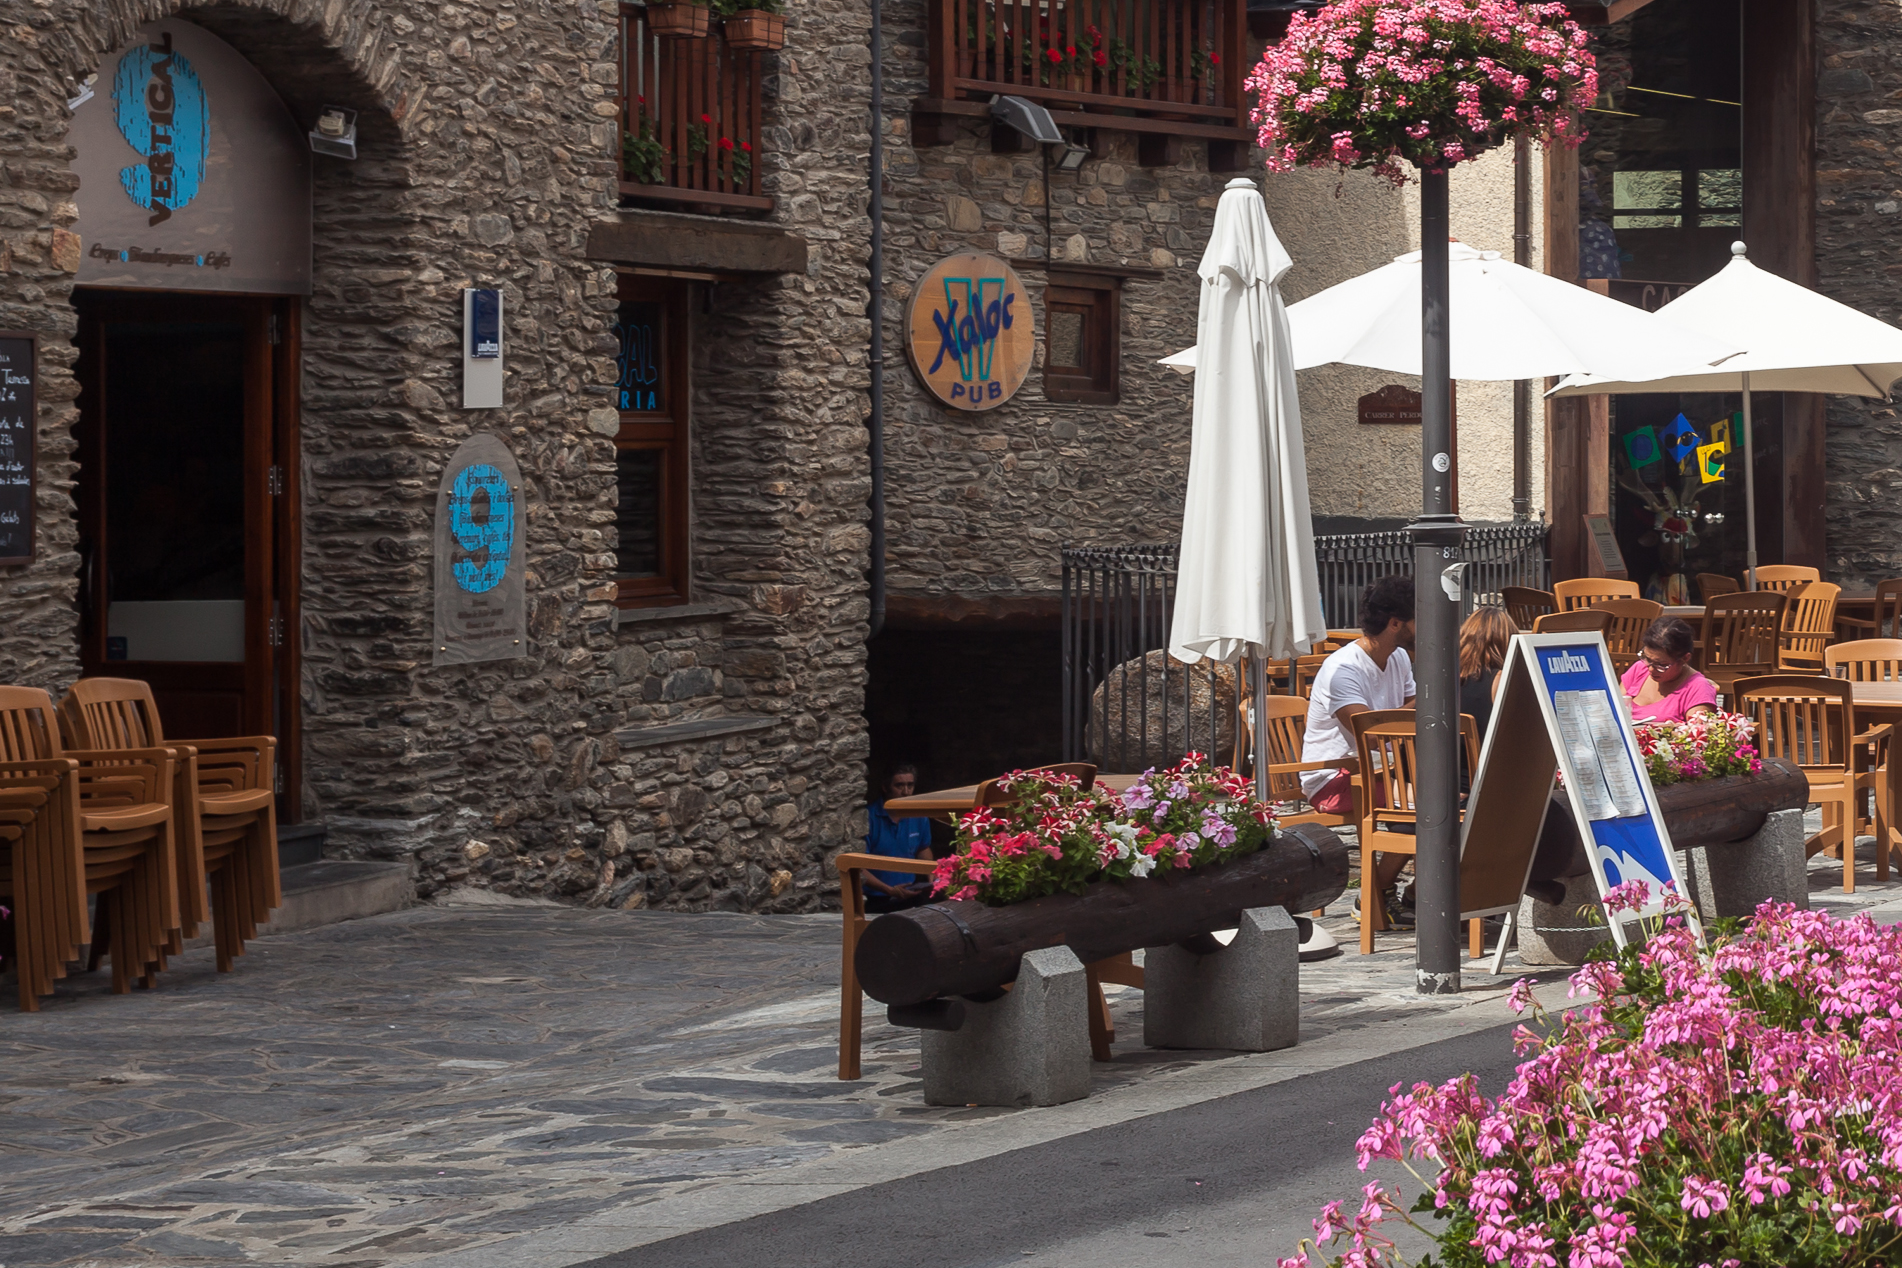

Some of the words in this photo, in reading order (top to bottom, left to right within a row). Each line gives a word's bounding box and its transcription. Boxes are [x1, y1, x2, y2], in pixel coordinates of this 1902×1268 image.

[149, 31, 173, 227] VERTICAL
[929, 292, 1015, 375] Xaloc
[951, 380, 1003, 403] PUB
[1365, 411, 1394, 419] CARRER
[1547, 650, 1591, 674] LAVAZZA
